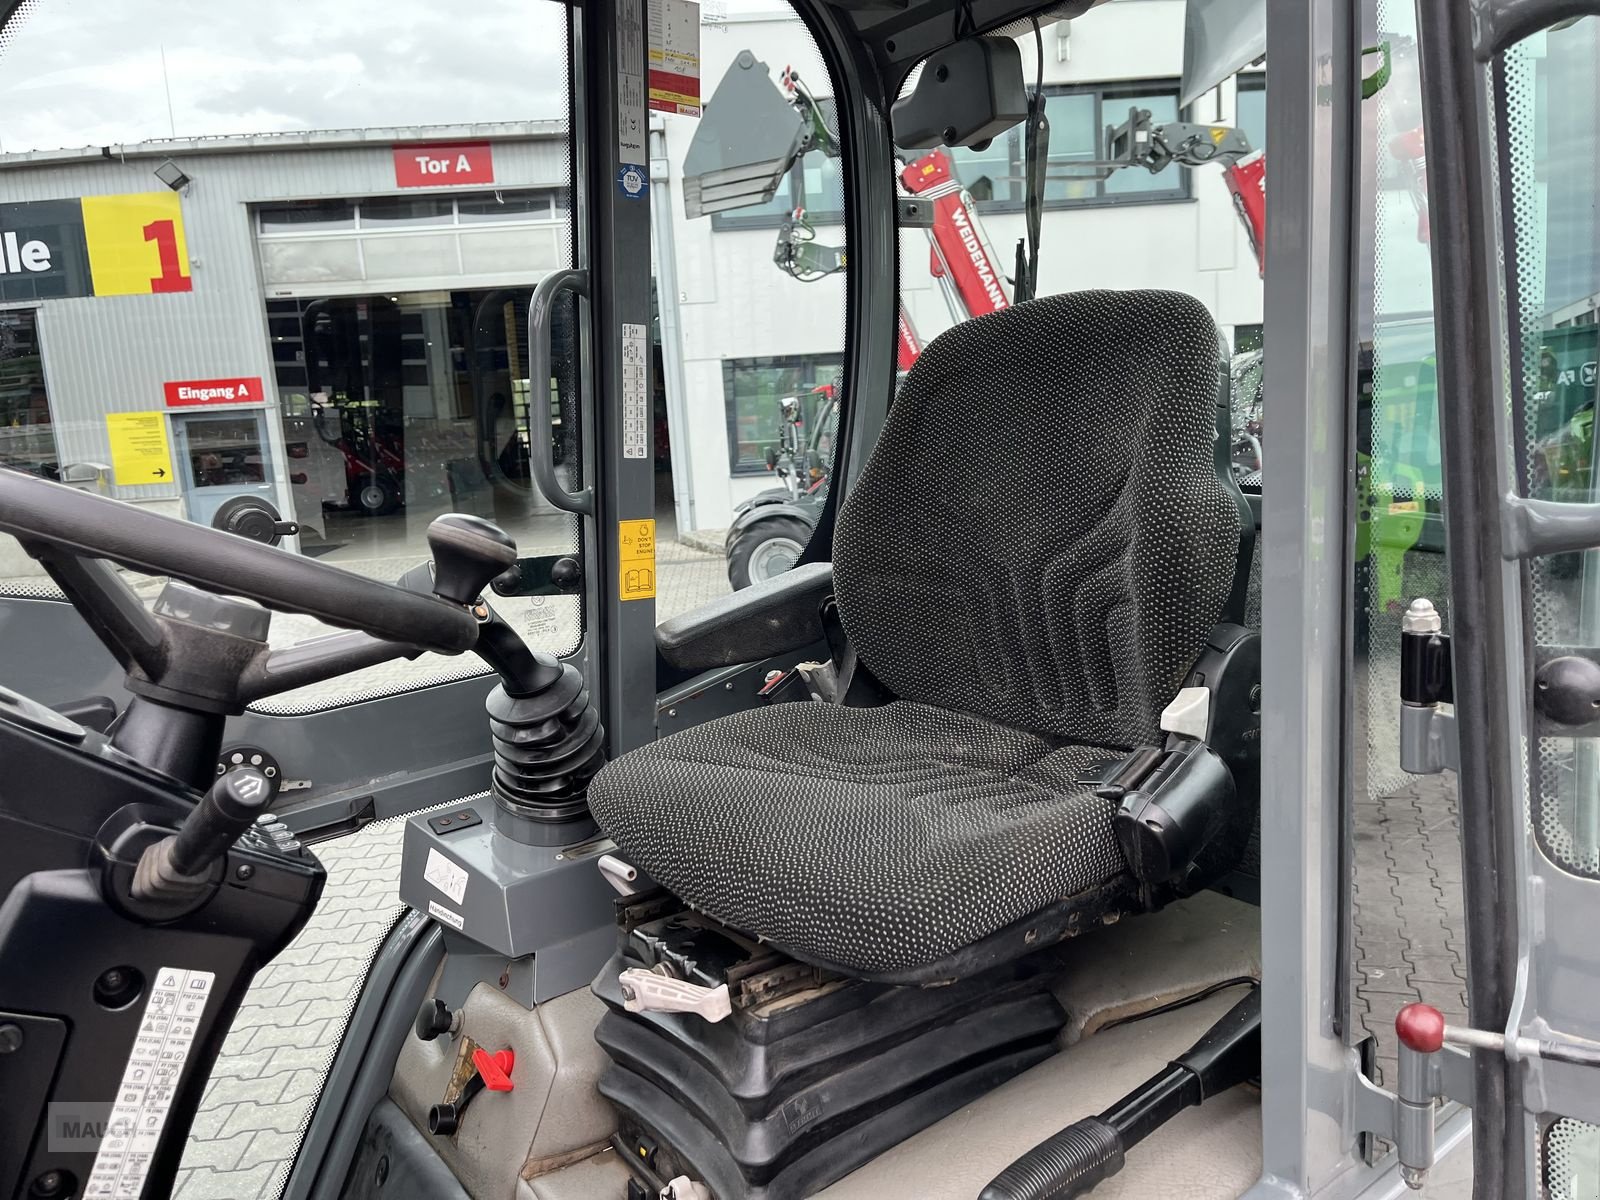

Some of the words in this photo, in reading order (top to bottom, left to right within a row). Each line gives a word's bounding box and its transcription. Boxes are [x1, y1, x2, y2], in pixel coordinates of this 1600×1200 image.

[415, 156, 450, 174] Tor
[455, 154, 472, 173] A
[143, 219, 193, 293] 1
[951, 207, 1006, 310] WEIDEMANN
[178, 387, 235, 401] Eingang
[238, 384, 249, 397] A
